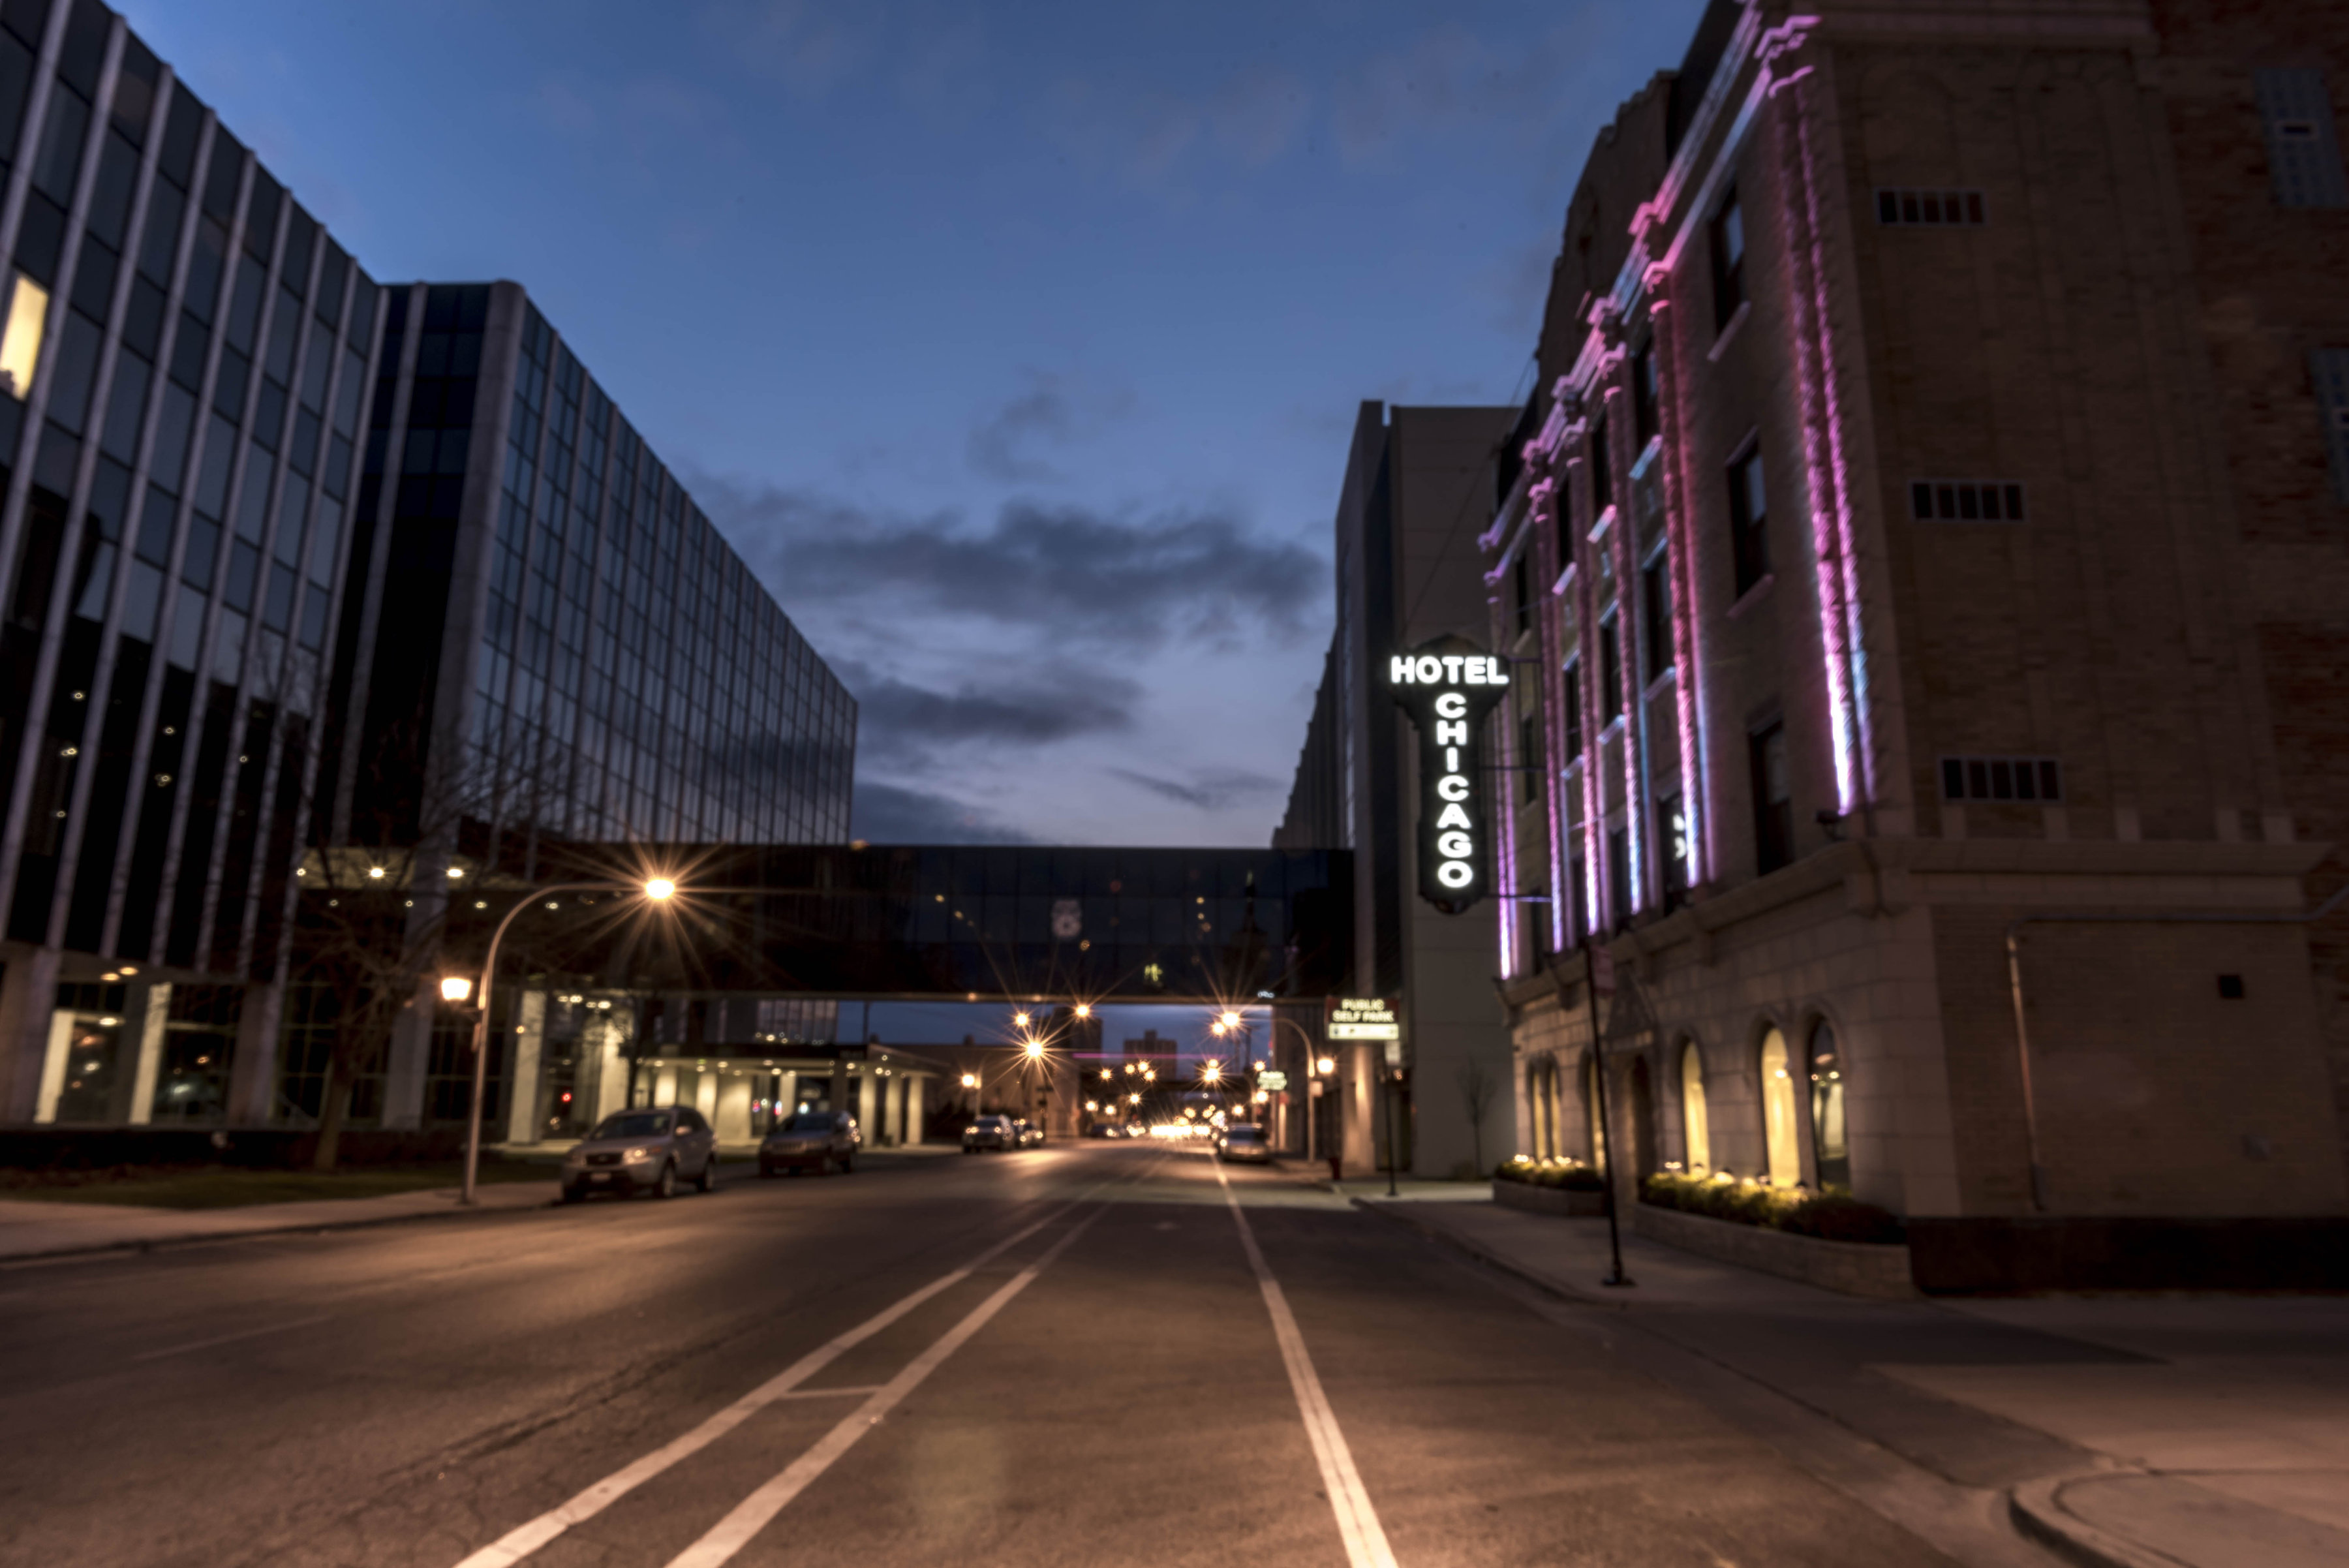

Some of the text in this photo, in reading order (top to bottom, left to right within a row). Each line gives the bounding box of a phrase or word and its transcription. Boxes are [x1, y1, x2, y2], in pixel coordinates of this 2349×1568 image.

[1390, 655, 1509, 684] HOTEL
[1436, 692, 1473, 888] CHICAGO
[1342, 999, 1385, 1011] PUBLIC
[1332, 1011, 1394, 1022] SELF PARK
